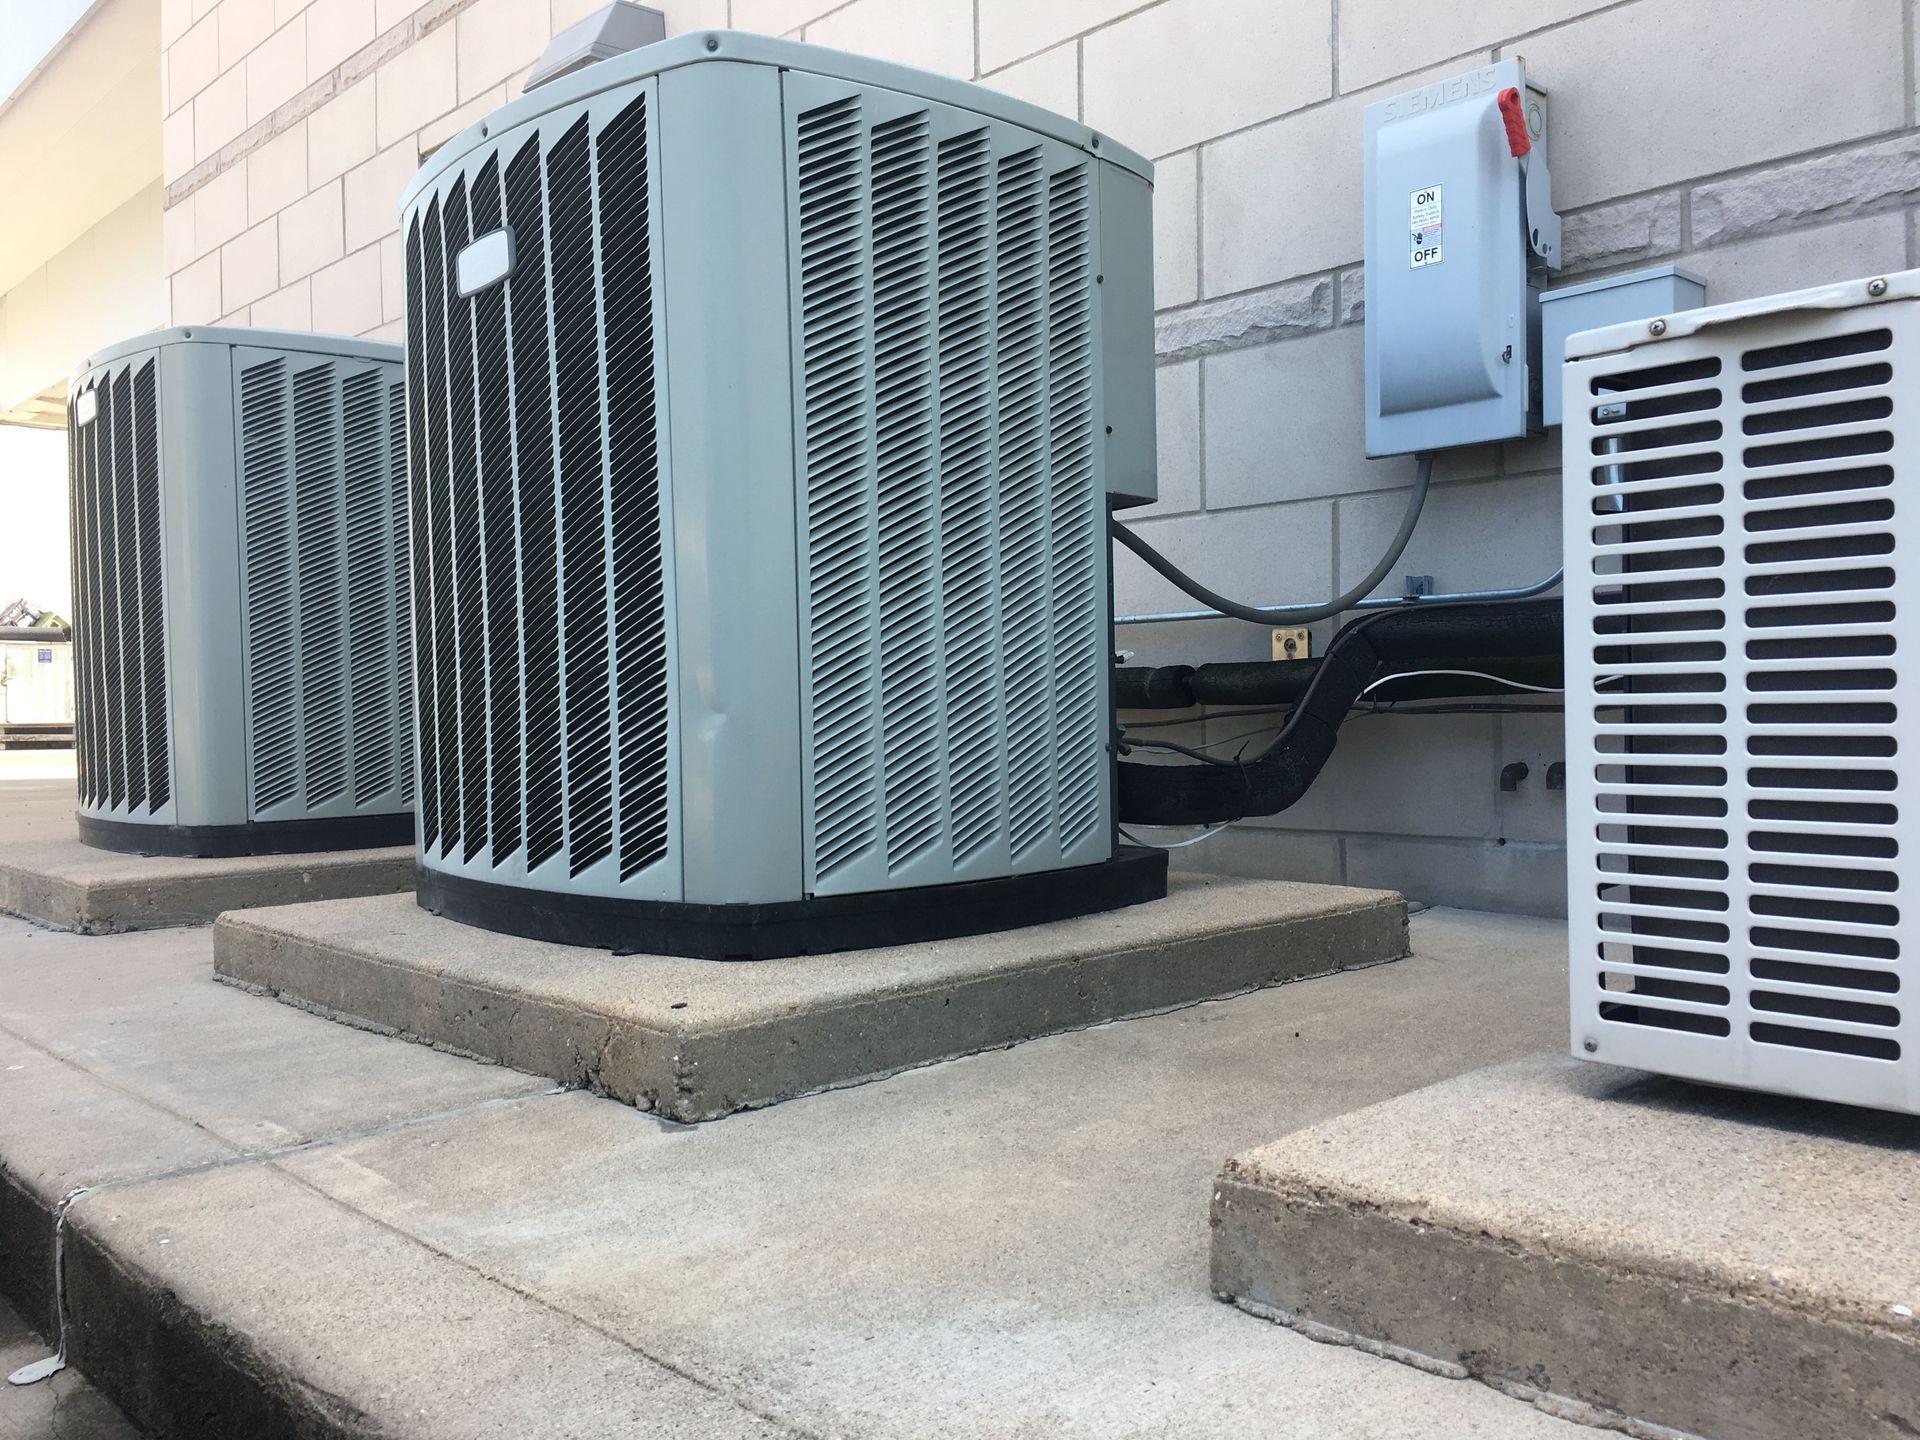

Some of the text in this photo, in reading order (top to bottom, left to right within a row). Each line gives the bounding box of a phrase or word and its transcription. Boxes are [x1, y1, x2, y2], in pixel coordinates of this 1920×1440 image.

[1383, 67, 1497, 124] SEMENS
[1416, 191, 1435, 205] ON
[1414, 247, 1439, 262] OFF
